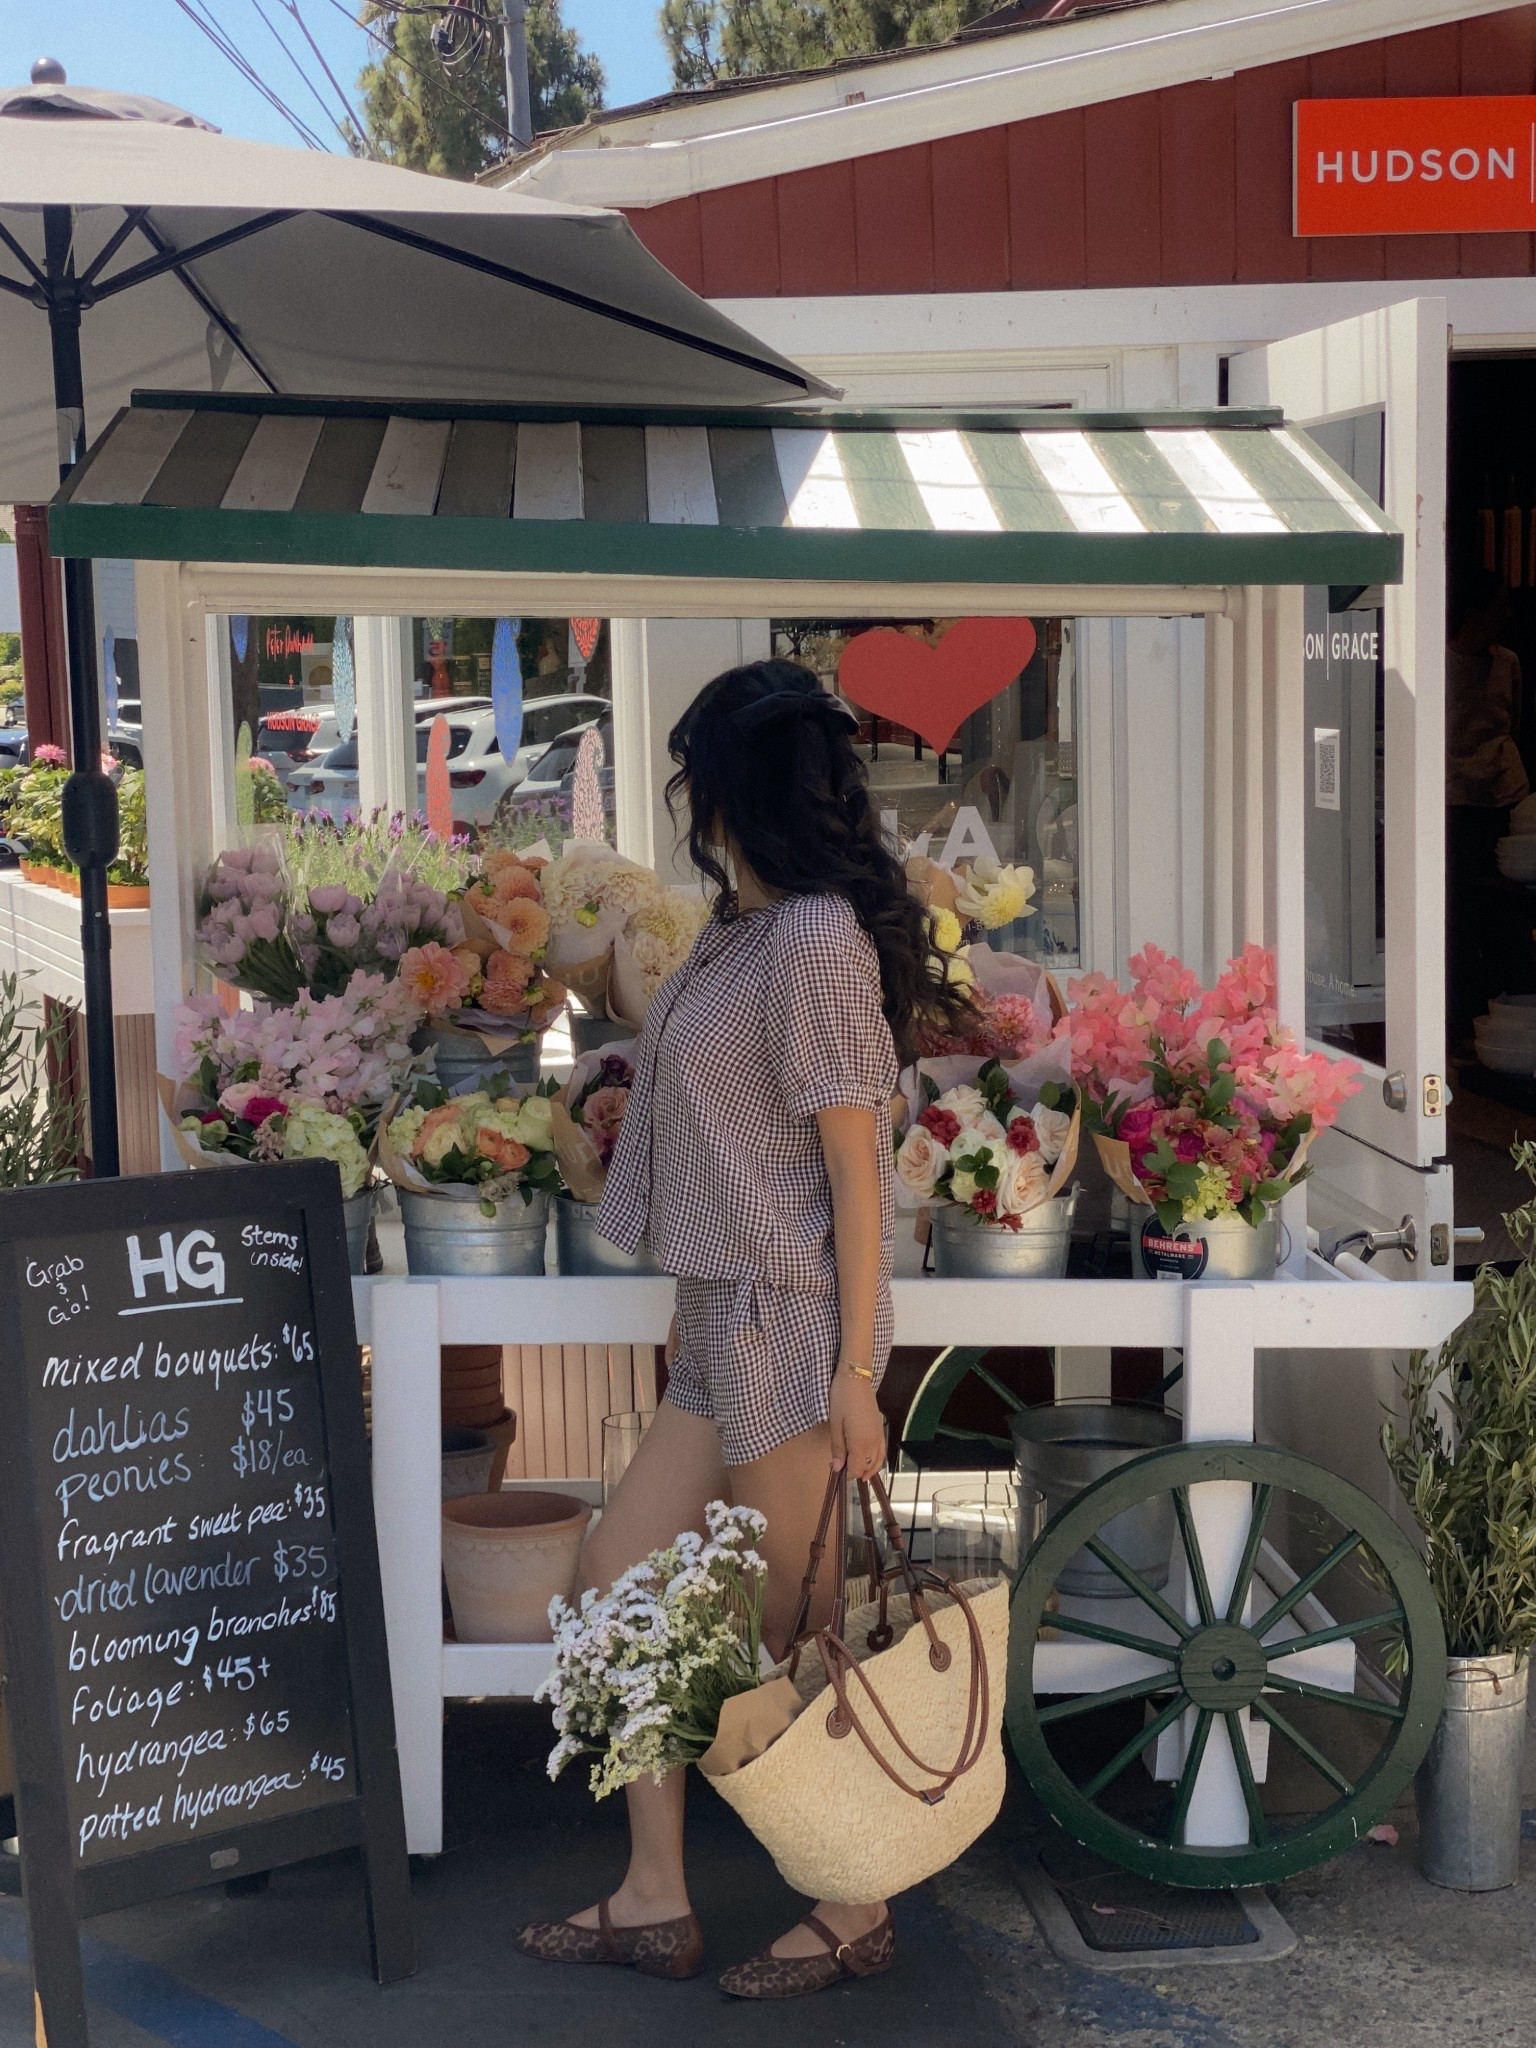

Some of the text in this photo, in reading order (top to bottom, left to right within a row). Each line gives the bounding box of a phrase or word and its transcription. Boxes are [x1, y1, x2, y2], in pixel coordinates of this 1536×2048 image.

[1317, 148, 1515, 183] HUDSON
[1331, 632, 1379, 661] GRACE
[267, 711, 295, 731] HUDSON
[1329, 972, 1335, 990] A
[241, 1224, 298, 1250] Stems
[1148, 1238, 1195, 1252] BEHRENS
[1154, 1250, 1186, 1259] METALWARE
[26, 1254, 84, 1287] Grab
[126, 1229, 226, 1298] HG
[250, 1252, 303, 1275] inside!
[48, 1284, 90, 1325] Go!
[43, 1323, 314, 1390] mixed bouquets: $65
[53, 1388, 294, 1463] dahlias $45
[58, 1482, 325, 1564] fragrant sweet pea: $35
[59, 1540, 328, 1621] dried lavender $35
[69, 1626, 199, 1671] blooming
[75, 1710, 290, 1798] hydrangea: $65
[79, 1751, 346, 1858] potted hydrangea: $45
